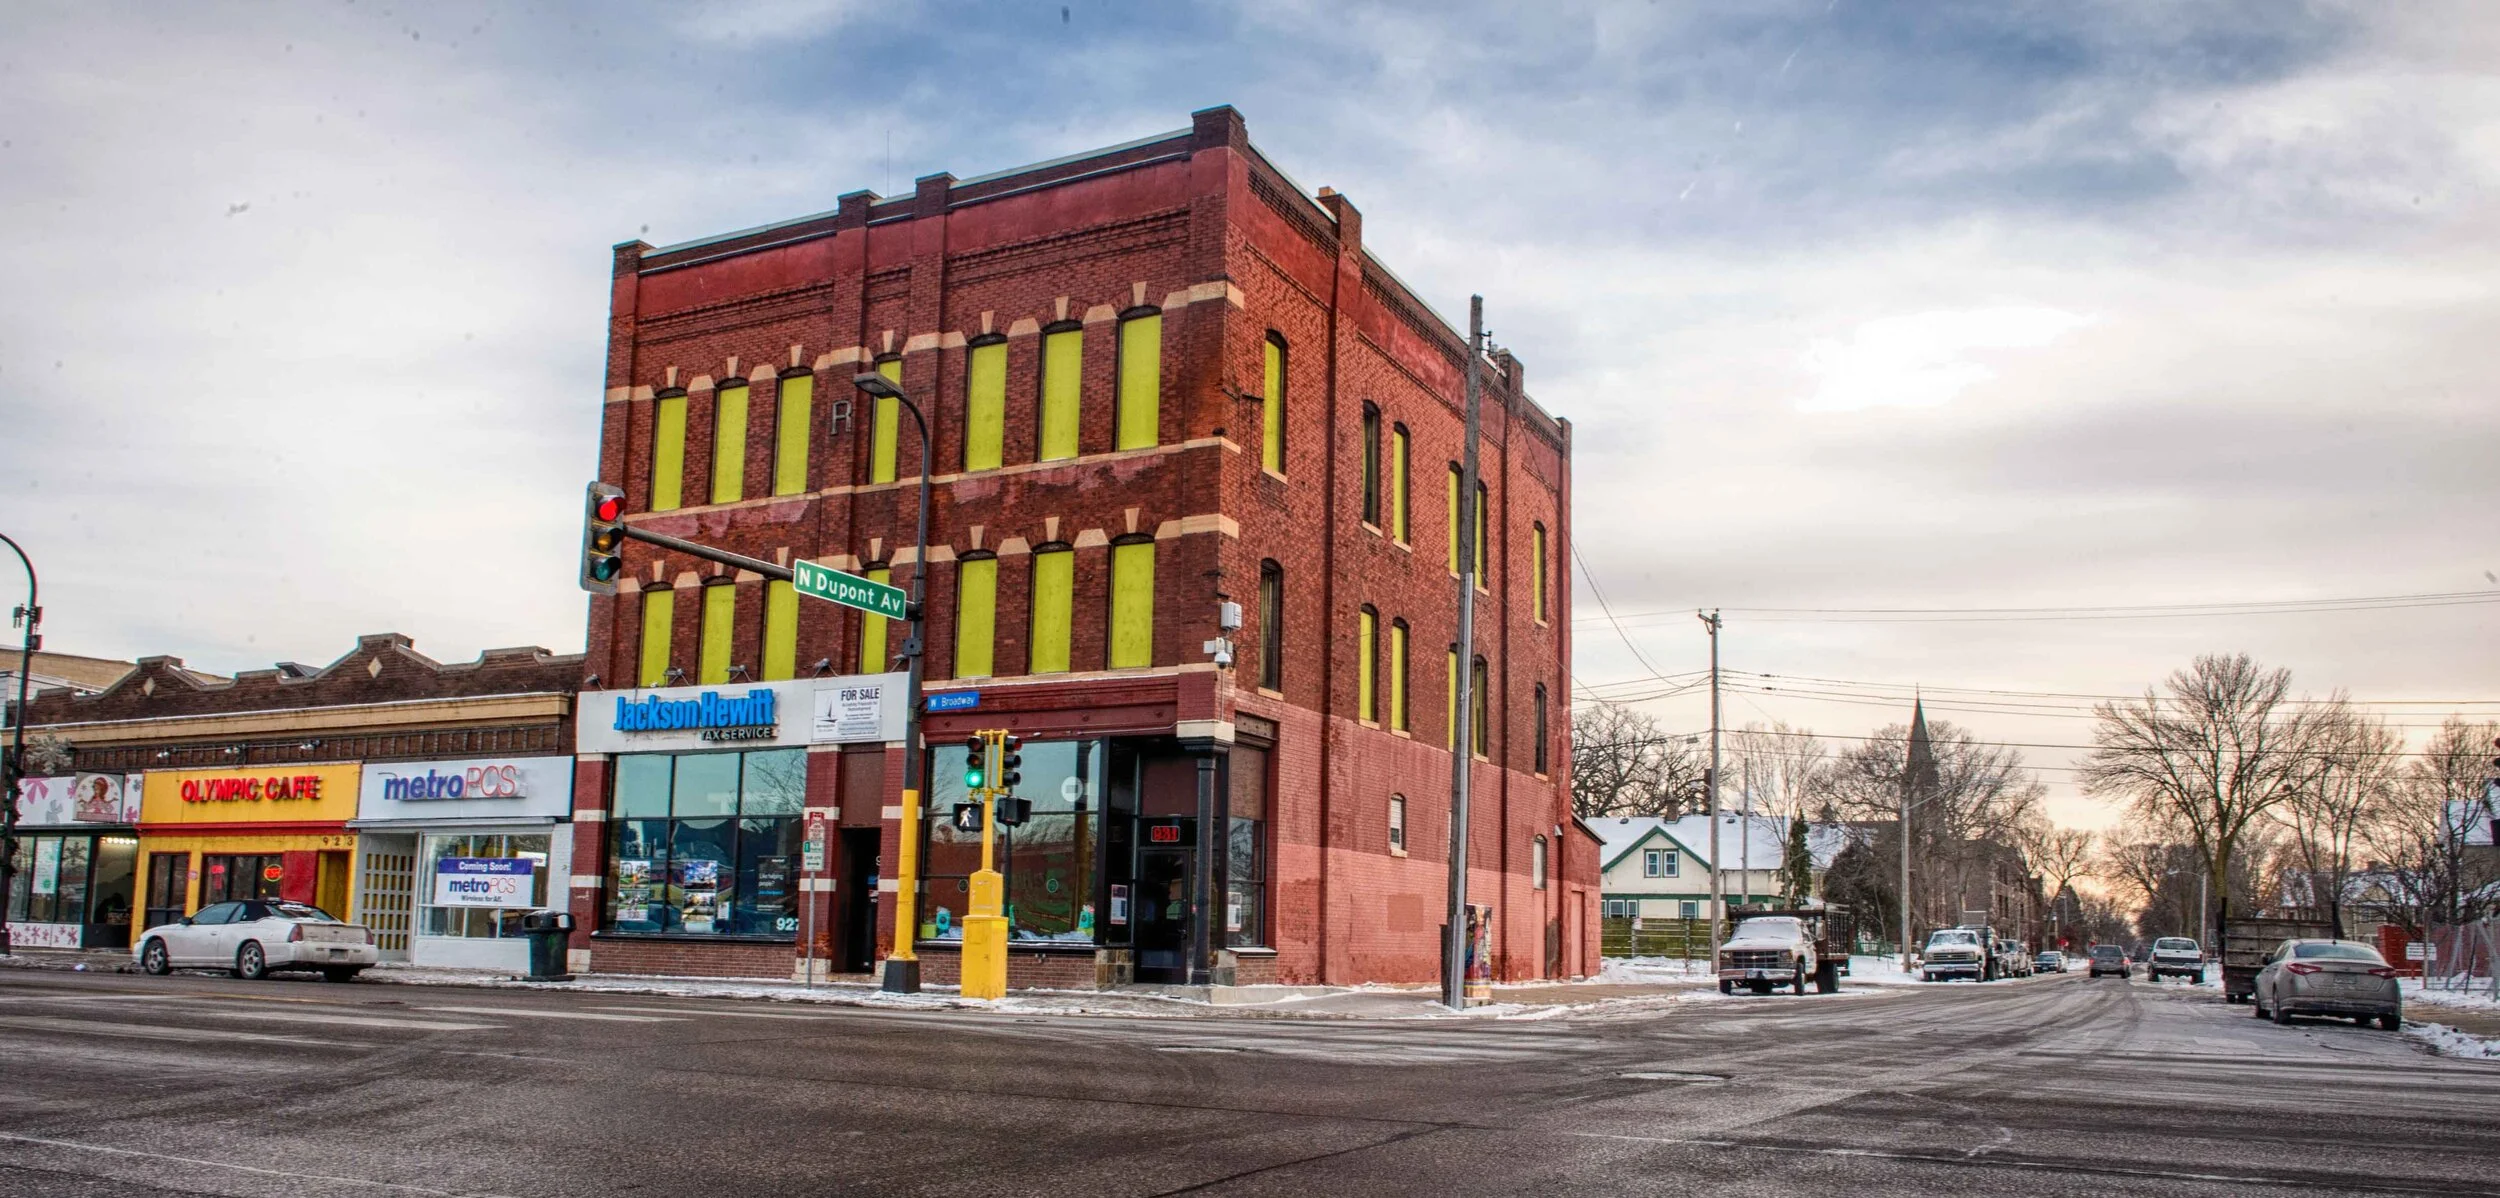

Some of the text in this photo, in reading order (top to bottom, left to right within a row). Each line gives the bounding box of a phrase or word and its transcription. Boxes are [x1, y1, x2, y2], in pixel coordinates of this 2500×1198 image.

[799, 567, 901, 612] N Dupont Av
[841, 688, 880, 701] FOR SALE
[930, 696, 976, 708] W Broadway
[613, 689, 775, 732] Jackson Hewitt
[723, 728, 771, 741] SERVICE
[181, 775, 321, 802] OLYMPIC CAFE
[384, 765, 517, 799] metroPCS
[323, 837, 353, 846] 923
[459, 862, 512, 872] Coming Soon!
[449, 877, 516, 894] metroPCS
[776, 917, 800, 931] 927
